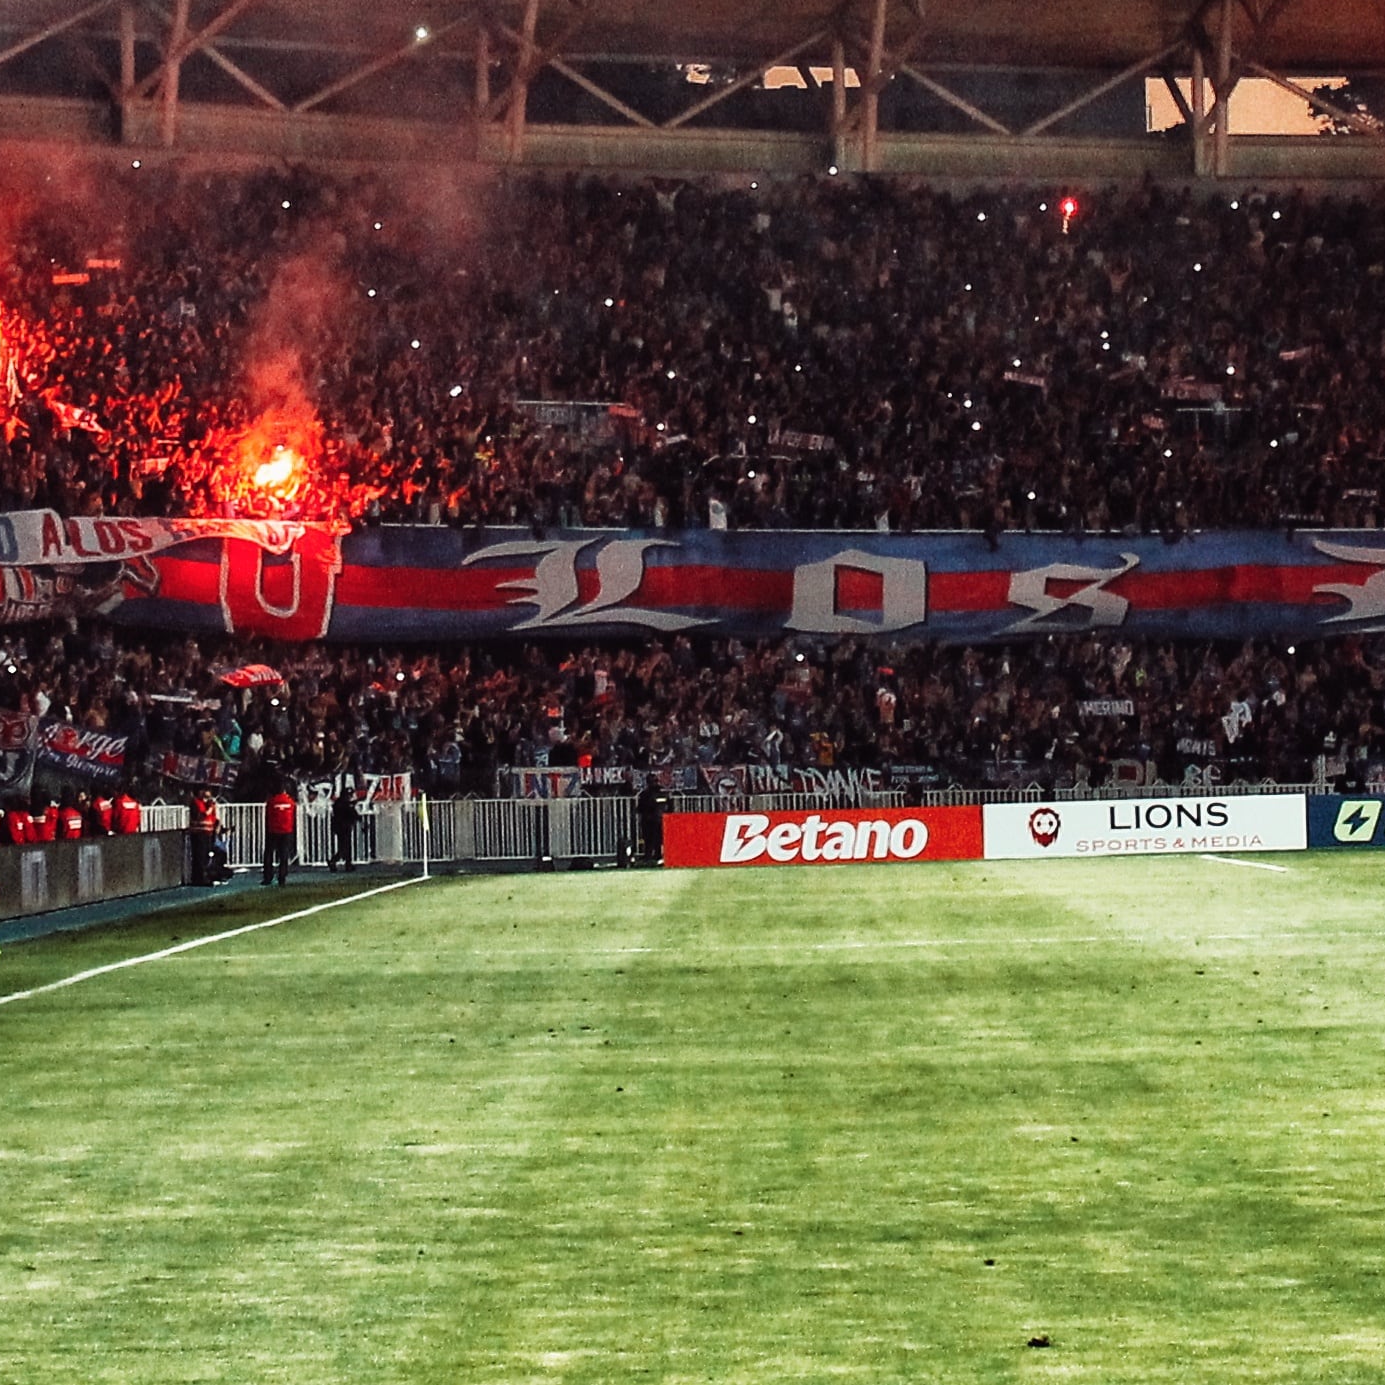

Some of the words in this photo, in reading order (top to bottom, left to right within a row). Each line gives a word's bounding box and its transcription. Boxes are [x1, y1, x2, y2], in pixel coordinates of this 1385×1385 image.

[42, 513, 62, 557] A
[68, 519, 153, 557] LOS
[462, 536, 1141, 635] Los
[719, 813, 928, 863] Betano
[1108, 802, 1229, 830] LIONS
[1075, 835, 1169, 853] SPORTS
[1172, 834, 1186, 850] &
[1189, 833, 1264, 850] MEDIA
